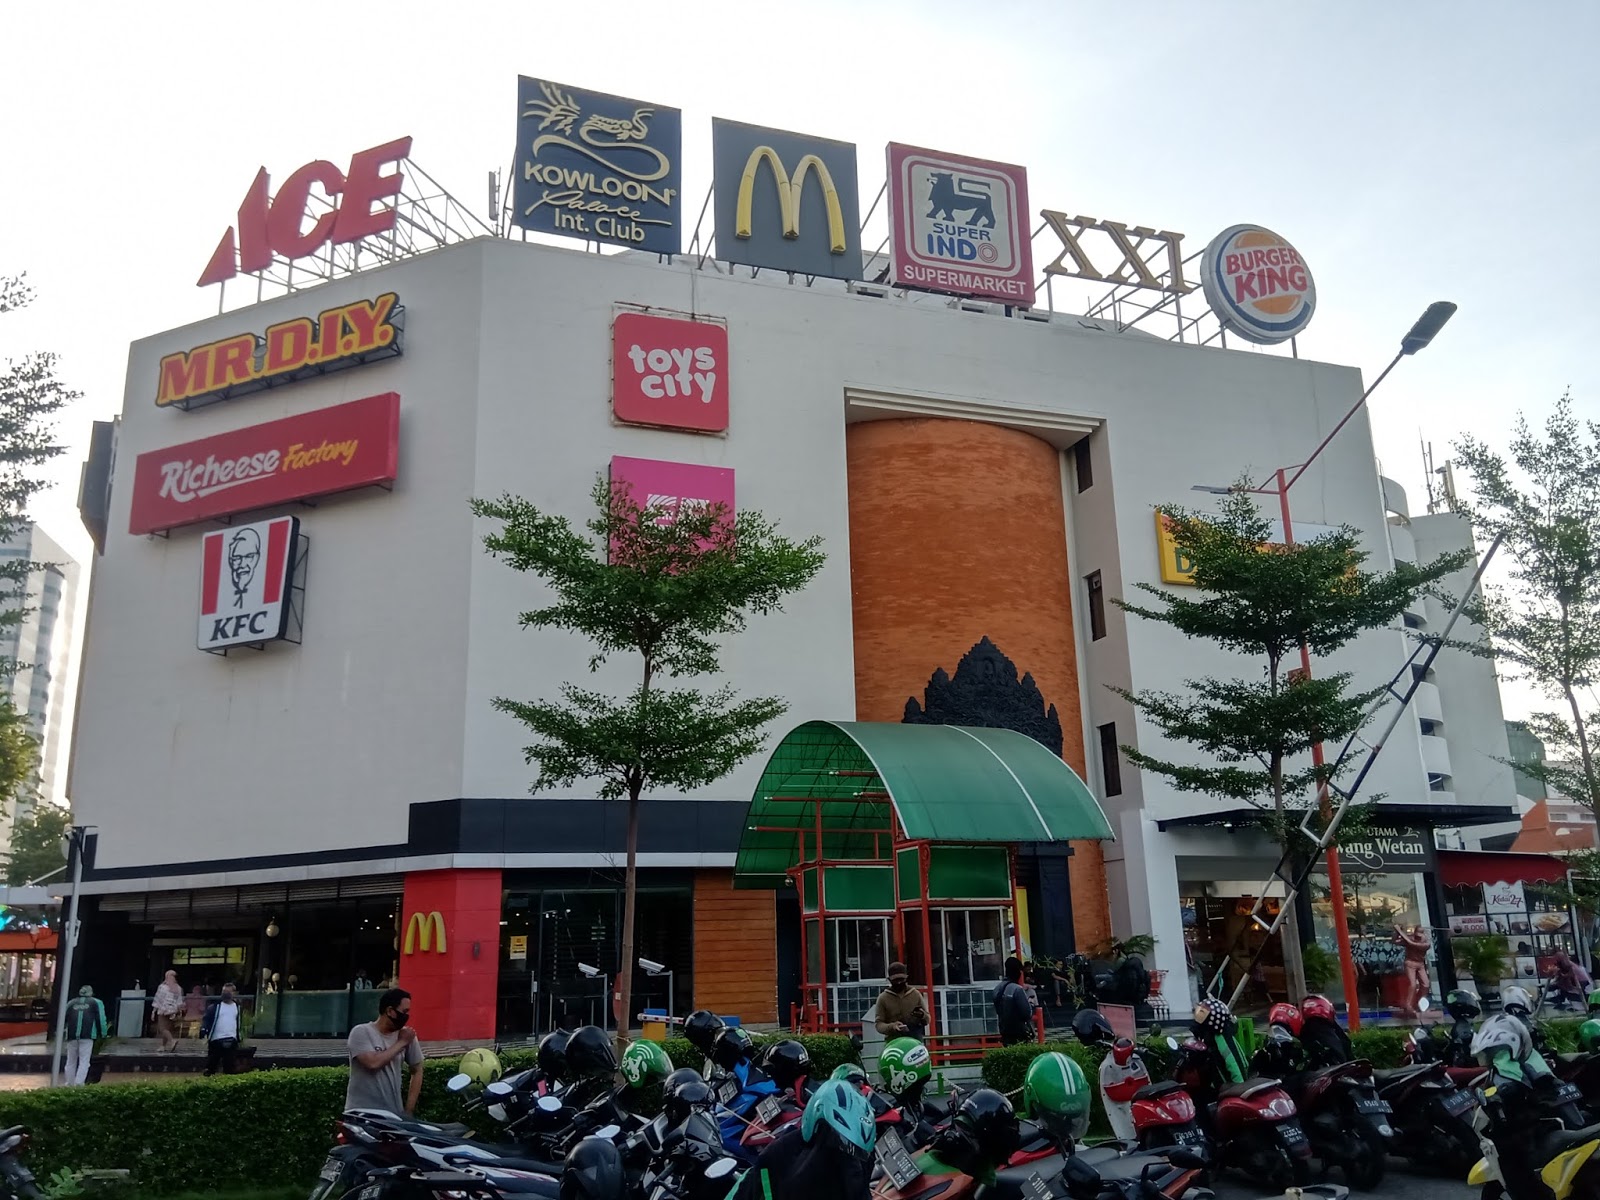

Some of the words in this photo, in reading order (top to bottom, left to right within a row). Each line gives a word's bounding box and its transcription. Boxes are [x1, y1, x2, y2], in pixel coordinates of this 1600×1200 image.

[197, 135, 413, 287] ACE
[525, 190, 672, 225] Palace
[554, 208, 590, 232] Int.
[595, 217, 645, 242] Club
[933, 223, 991, 242] SUPER
[927, 234, 998, 263] INDO
[1040, 209, 1193, 294] XXI
[1226, 248, 1300, 276] BURGER
[904, 265, 1026, 295] SUPERMARKET
[1235, 265, 1307, 304] KING
[628, 344, 715, 374] toys
[641, 372, 716, 403] city
[159, 449, 281, 502] Richeese
[282, 439, 358, 472] Factory
[210, 611, 267, 641] KFC
[1375, 839, 1425, 854] Wetan
